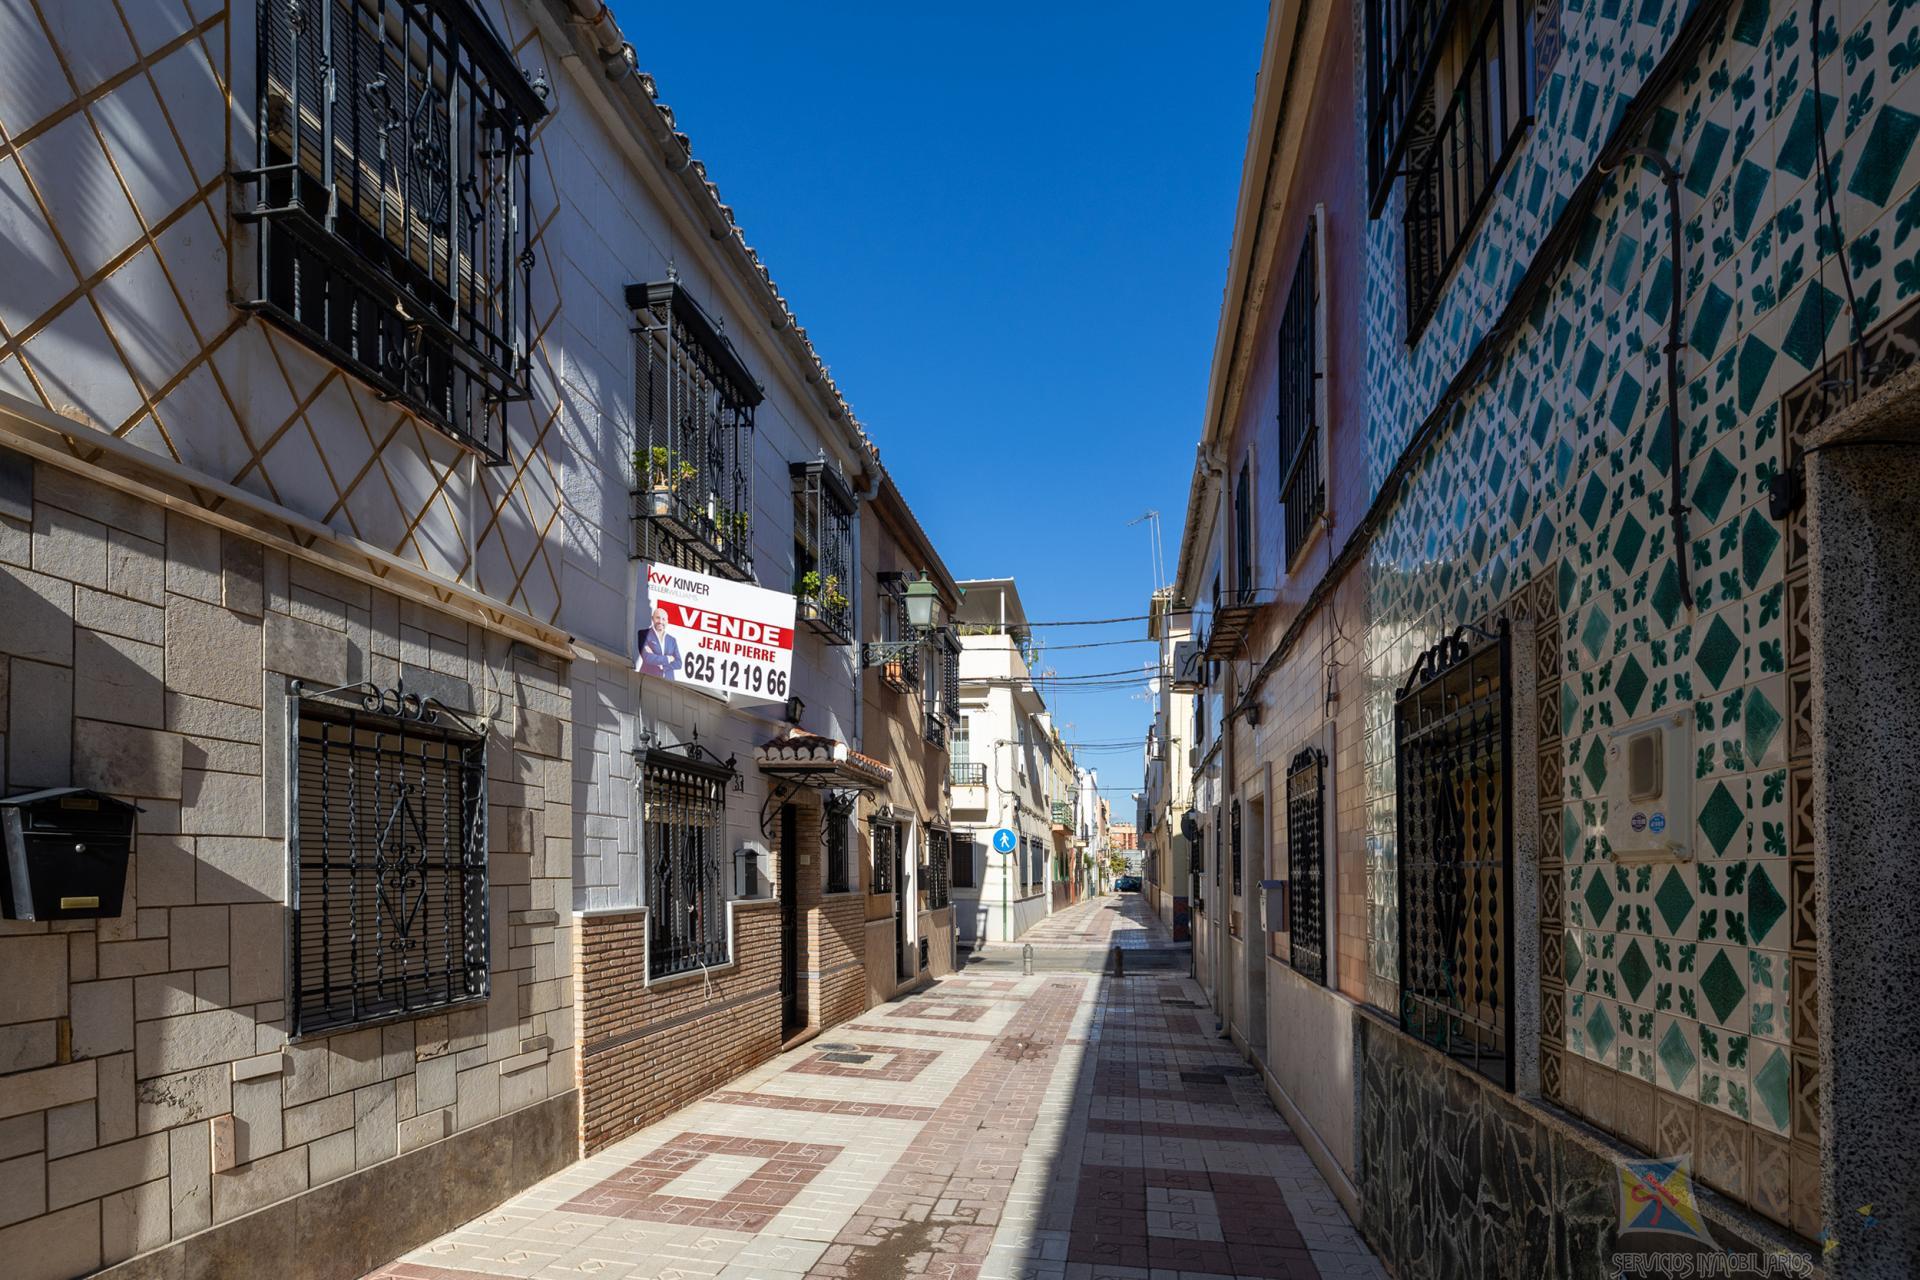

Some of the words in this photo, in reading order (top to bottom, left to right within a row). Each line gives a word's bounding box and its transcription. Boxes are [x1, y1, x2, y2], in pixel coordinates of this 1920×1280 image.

[674, 576, 710, 597] KINVER
[678, 606, 781, 646] VENDE
[698, 636, 731, 654] JEAN
[735, 645, 776, 663] PIERRE
[684, 651, 715, 683] 625
[721, 659, 739, 688] 12
[744, 664, 762, 692] 19
[767, 669, 786, 697] 66
